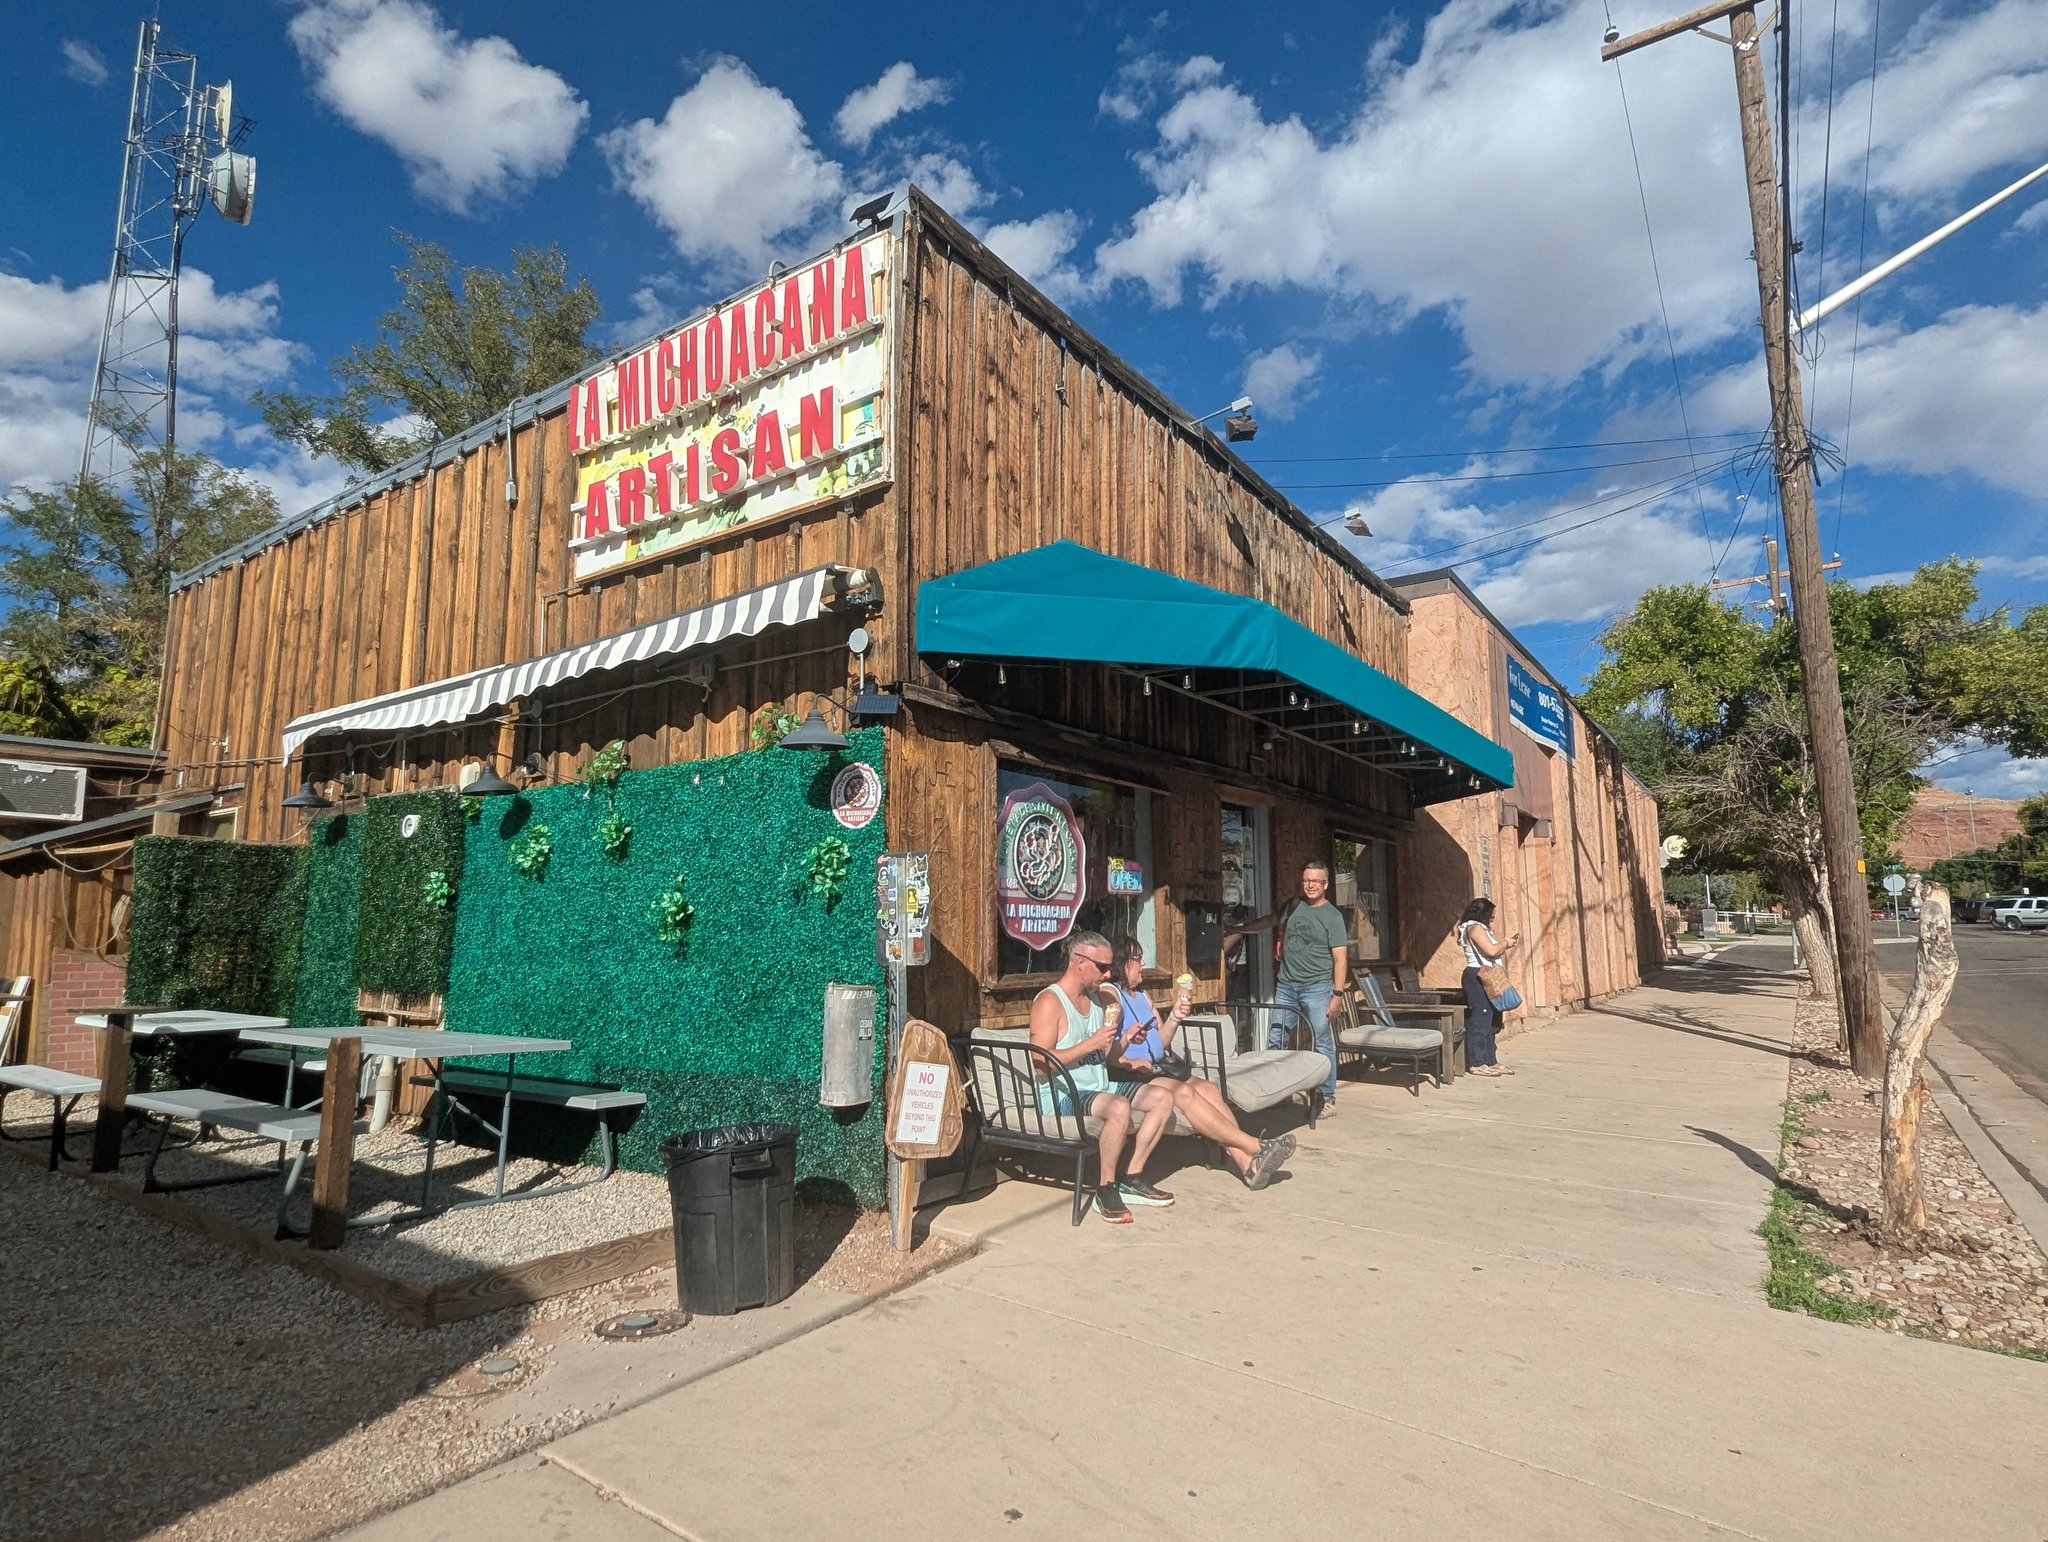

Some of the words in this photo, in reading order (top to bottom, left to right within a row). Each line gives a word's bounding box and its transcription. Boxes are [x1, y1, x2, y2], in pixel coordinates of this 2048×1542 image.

[567, 375, 601, 453] LA
[618, 245, 867, 433] MICHOACANA
[584, 385, 834, 540] ARTISAN
[1111, 870, 1142, 890] OPEN
[1007, 903, 1016, 918] LA
[1019, 903, 1071, 919] MICHOACANA
[1021, 919, 1057, 933] ARTISAN
[918, 1071, 935, 1085] NO
[906, 1088, 942, 1099] UNAUTHORIZED
[911, 1101, 934, 1110] VEHICLES
[904, 1112, 924, 1121] BEYOND
[925, 1114, 936, 1122] THIS
[911, 1125, 926, 1134] POINT
